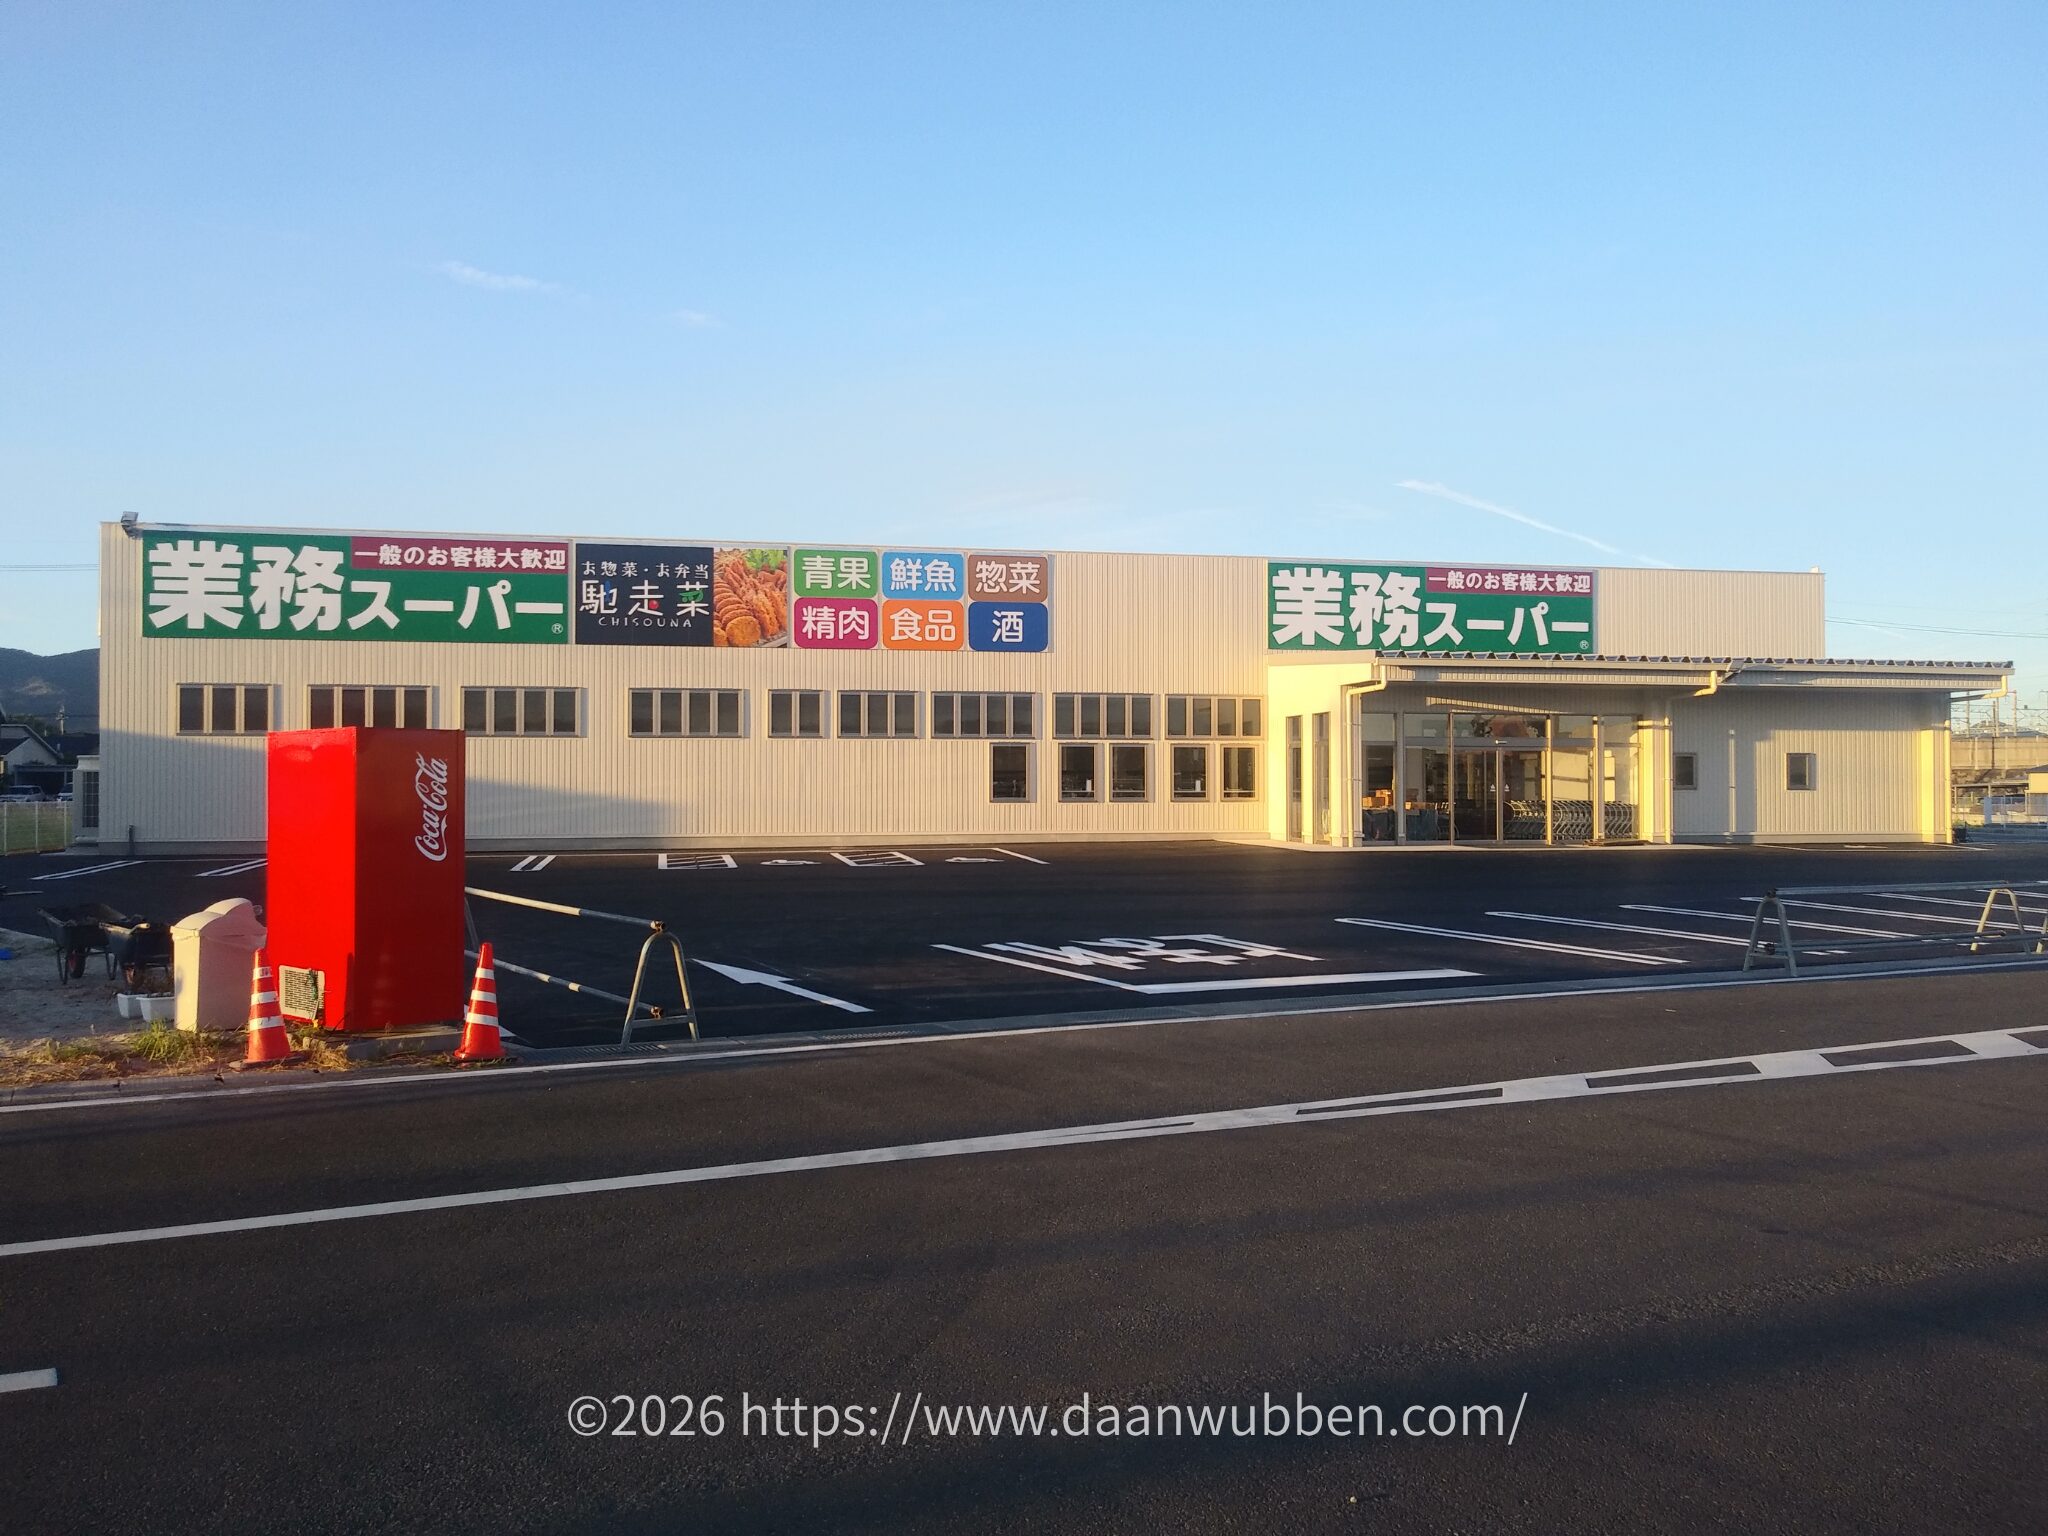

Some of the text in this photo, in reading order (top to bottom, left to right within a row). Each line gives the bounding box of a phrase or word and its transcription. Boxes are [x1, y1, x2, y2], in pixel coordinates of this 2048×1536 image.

[354, 543, 567, 571] 一般のお客様大歓迎
[582, 560, 709, 580] お惣菜・お弁当
[801, 555, 871, 590] 青果
[148, 540, 564, 631] 業務スーパー
[890, 558, 957, 592] 鮮魚
[975, 560, 1041, 594] 惣菜
[1428, 571, 1591, 593] 一般のお客様大歓迎
[580, 580, 710, 617] 馳走菜
[1272, 567, 1589, 647] 業務スーパー
[598, 616, 693, 628] CHISOUNA
[802, 605, 870, 640] 精肉
[889, 607, 956, 642] 食品
[992, 610, 1024, 643] 酒
[415, 750, 448, 863] Coca-Cola
[982, 934, 1325, 970] 止まれ
